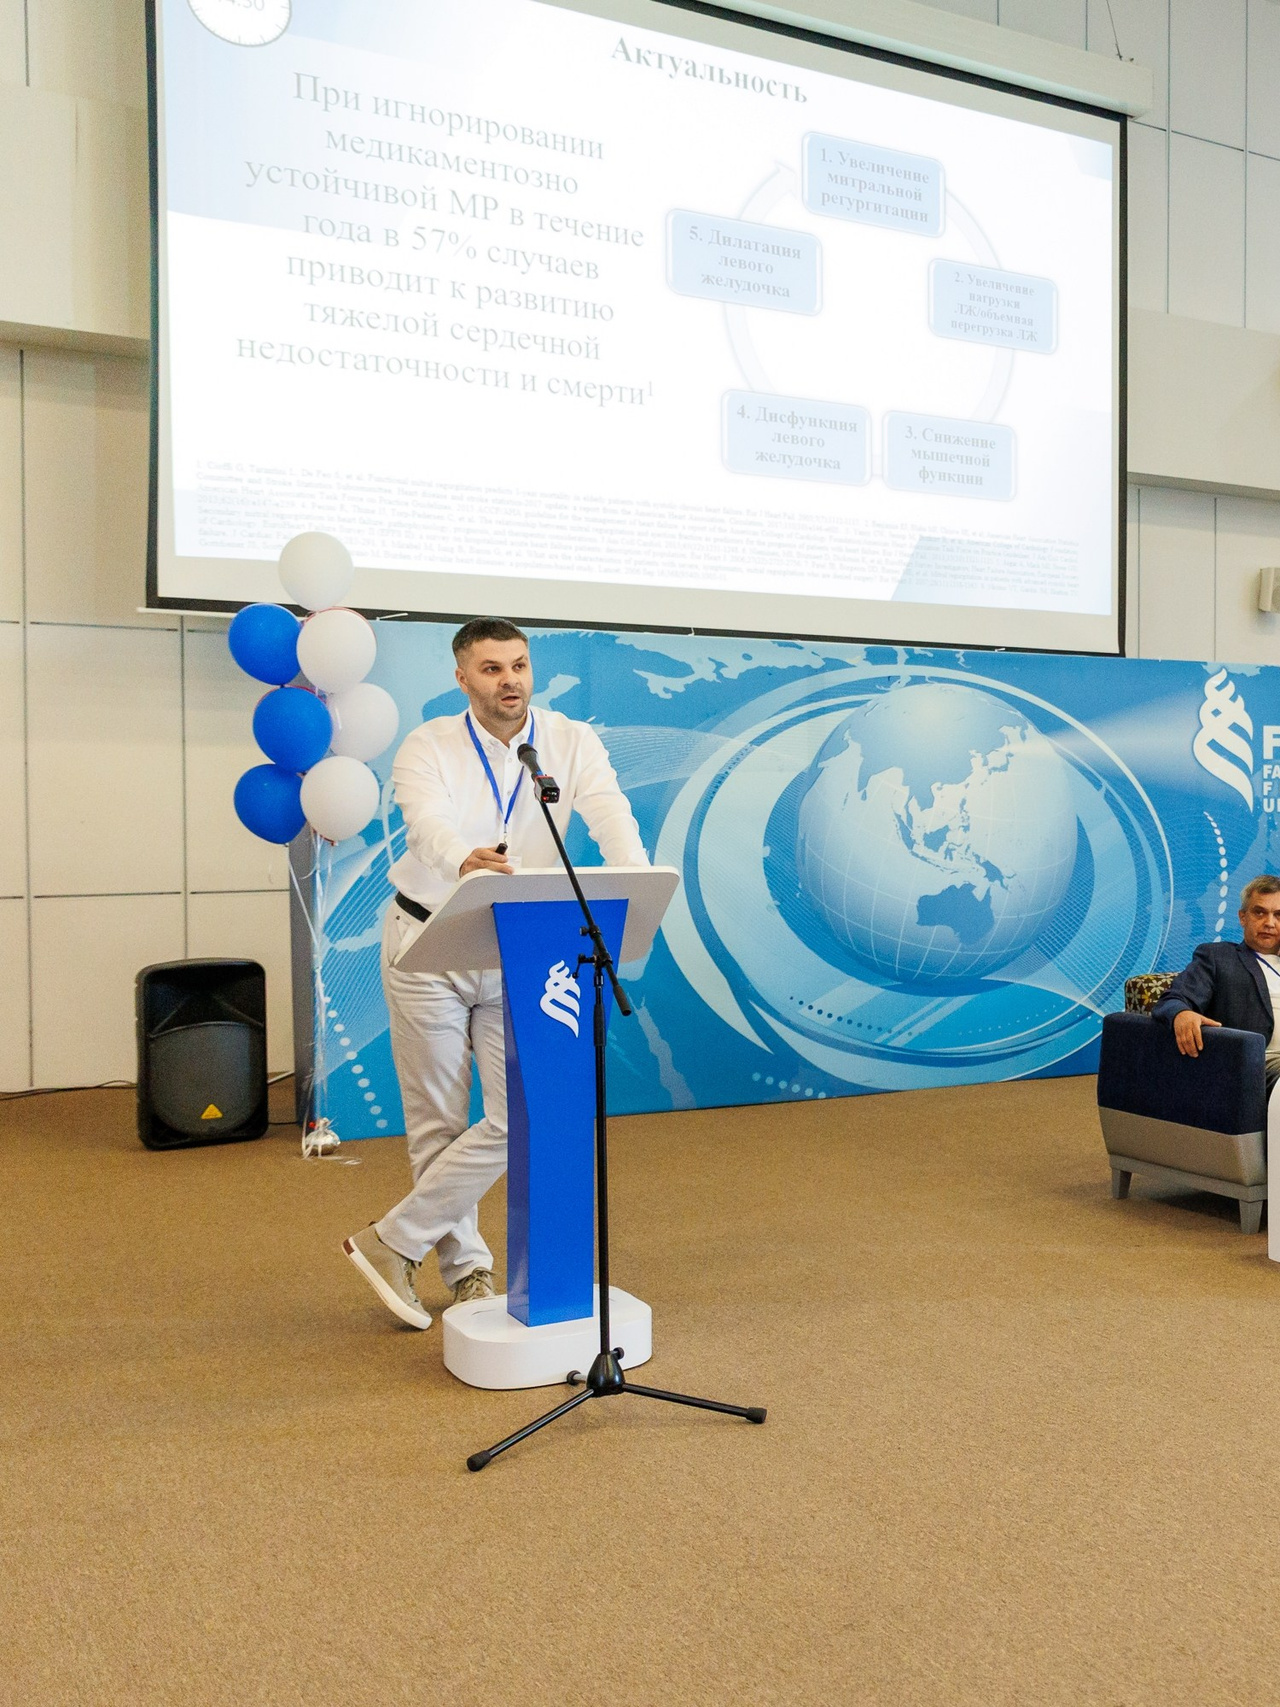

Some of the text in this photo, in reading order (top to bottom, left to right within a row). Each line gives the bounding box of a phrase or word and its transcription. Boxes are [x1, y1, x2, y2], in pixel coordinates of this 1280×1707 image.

[611, 37, 807, 103] Актуальность
[293, 72, 603, 160] При игнорировании
[326, 130, 578, 194] медикаментозно
[821, 148, 929, 184] 1. Увеличение
[827, 172, 922, 202] митральной
[244, 161, 644, 247] устойчивой МР в течение
[821, 192, 928, 223] регургитации
[303, 215, 599, 279] года в 57% случаев
[689, 225, 801, 259] 5. Дилатация
[718, 255, 774, 274] левого
[287, 256, 614, 321] приводит к развитию
[701, 274, 790, 298] желудочка
[304, 303, 600, 360] тяжелой сердечной
[237, 338, 509, 389] недостаточности
[521, 374, 536, 392] и
[736, 404, 857, 433] 4. Дисфункция
[771, 432, 825, 448] левого
[904, 425, 996, 450] 3. Снижение
[755, 451, 841, 470] желудочка
[911, 449, 990, 467] мышечной
[918, 465, 983, 486] функции
